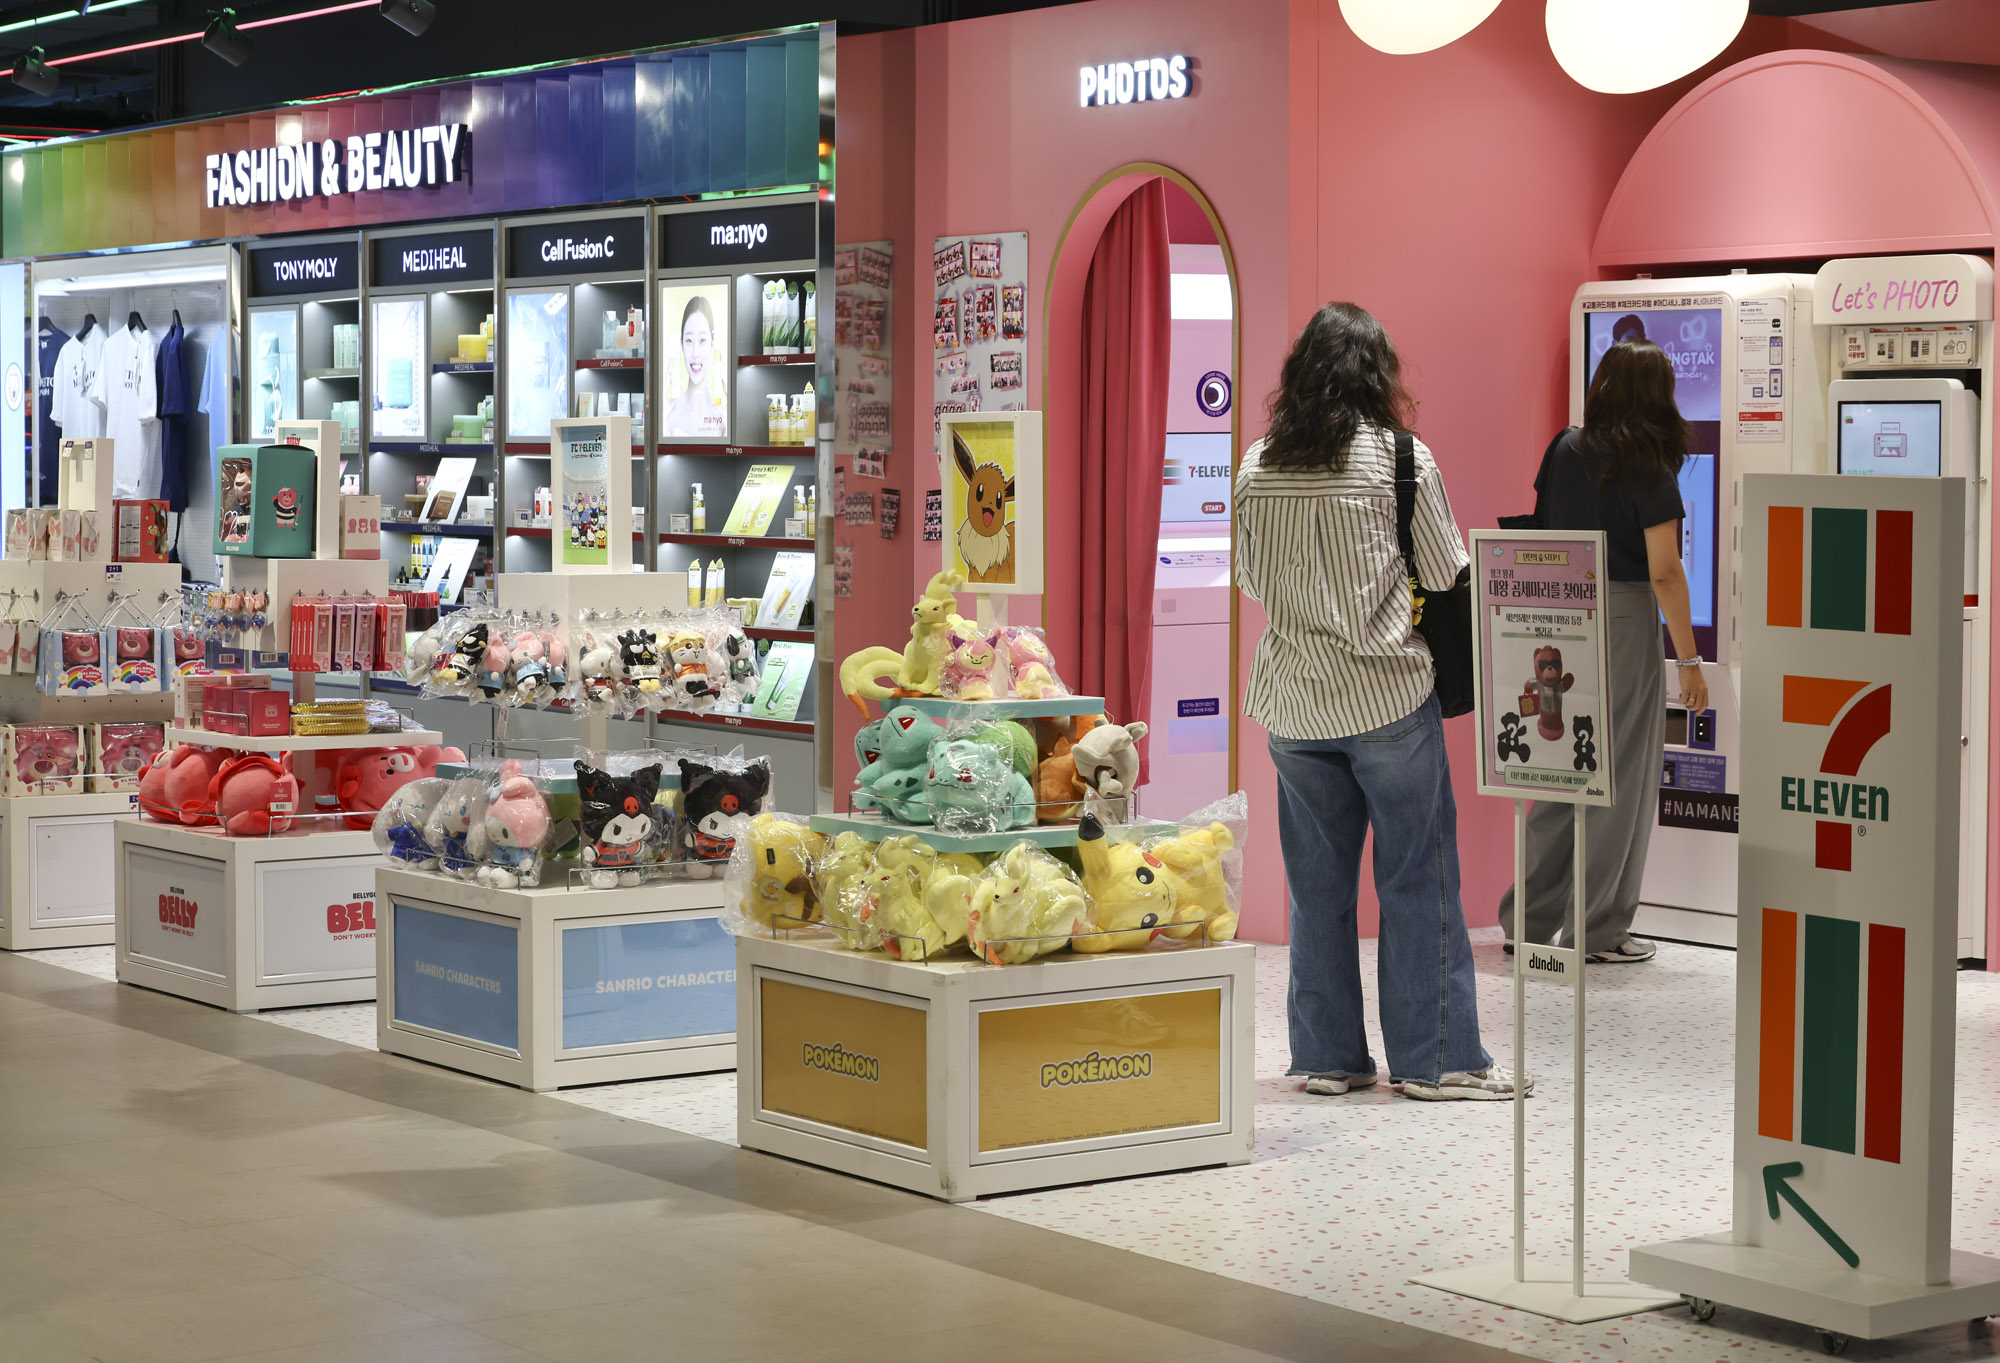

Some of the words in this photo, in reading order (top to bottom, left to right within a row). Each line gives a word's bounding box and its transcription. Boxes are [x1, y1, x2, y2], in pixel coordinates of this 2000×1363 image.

[1080, 55, 1187, 107] PHOTOS
[206, 141, 314, 208] FASHION
[320, 138, 340, 196] &
[347, 123, 460, 192] BEAUTY
[710, 223, 768, 250] ma:nyo
[541, 238, 564, 262] Cell
[564, 237, 603, 260] Fusion
[604, 235, 615, 258] C
[273, 257, 338, 281] TONYMOLY
[402, 246, 467, 273] MEDIHEAL
[1832, 282, 1878, 313] Let's
[1883, 280, 1959, 311] PHOTO
[454, 363, 475, 371] MEDIHEAL
[770, 355, 787, 364] ma:nyo
[1667, 351, 1715, 365] NGTAK
[419, 444, 440, 452] MEDIHEAL
[725, 447, 743, 455] ma:nyo
[1188, 465, 1231, 478] 7-ELEVE
[1204, 504, 1223, 512] START
[422, 525, 442, 533] MEDIHEAL
[1489, 580, 1509, 598] 대왕
[1511, 581, 1560, 599] 곰세마리를
[1563, 583, 1597, 600] 찾아라!
[724, 717, 742, 726] ma:nyo
[1586, 787, 1605, 796] dundun
[1663, 800, 1739, 822] #NAMANE
[158, 894, 198, 929] BELLY
[327, 901, 376, 934] BEL
[354, 932, 376, 940] WORRY
[1529, 952, 1565, 973] dundun
[415, 960, 445, 980] SANRIO
[446, 969, 501, 994] CHARACTERS
[595, 976, 651, 994] SANRIO
[803, 1042, 880, 1082] POKÉMON
[1041, 1050, 1152, 1088] POKÉMON
